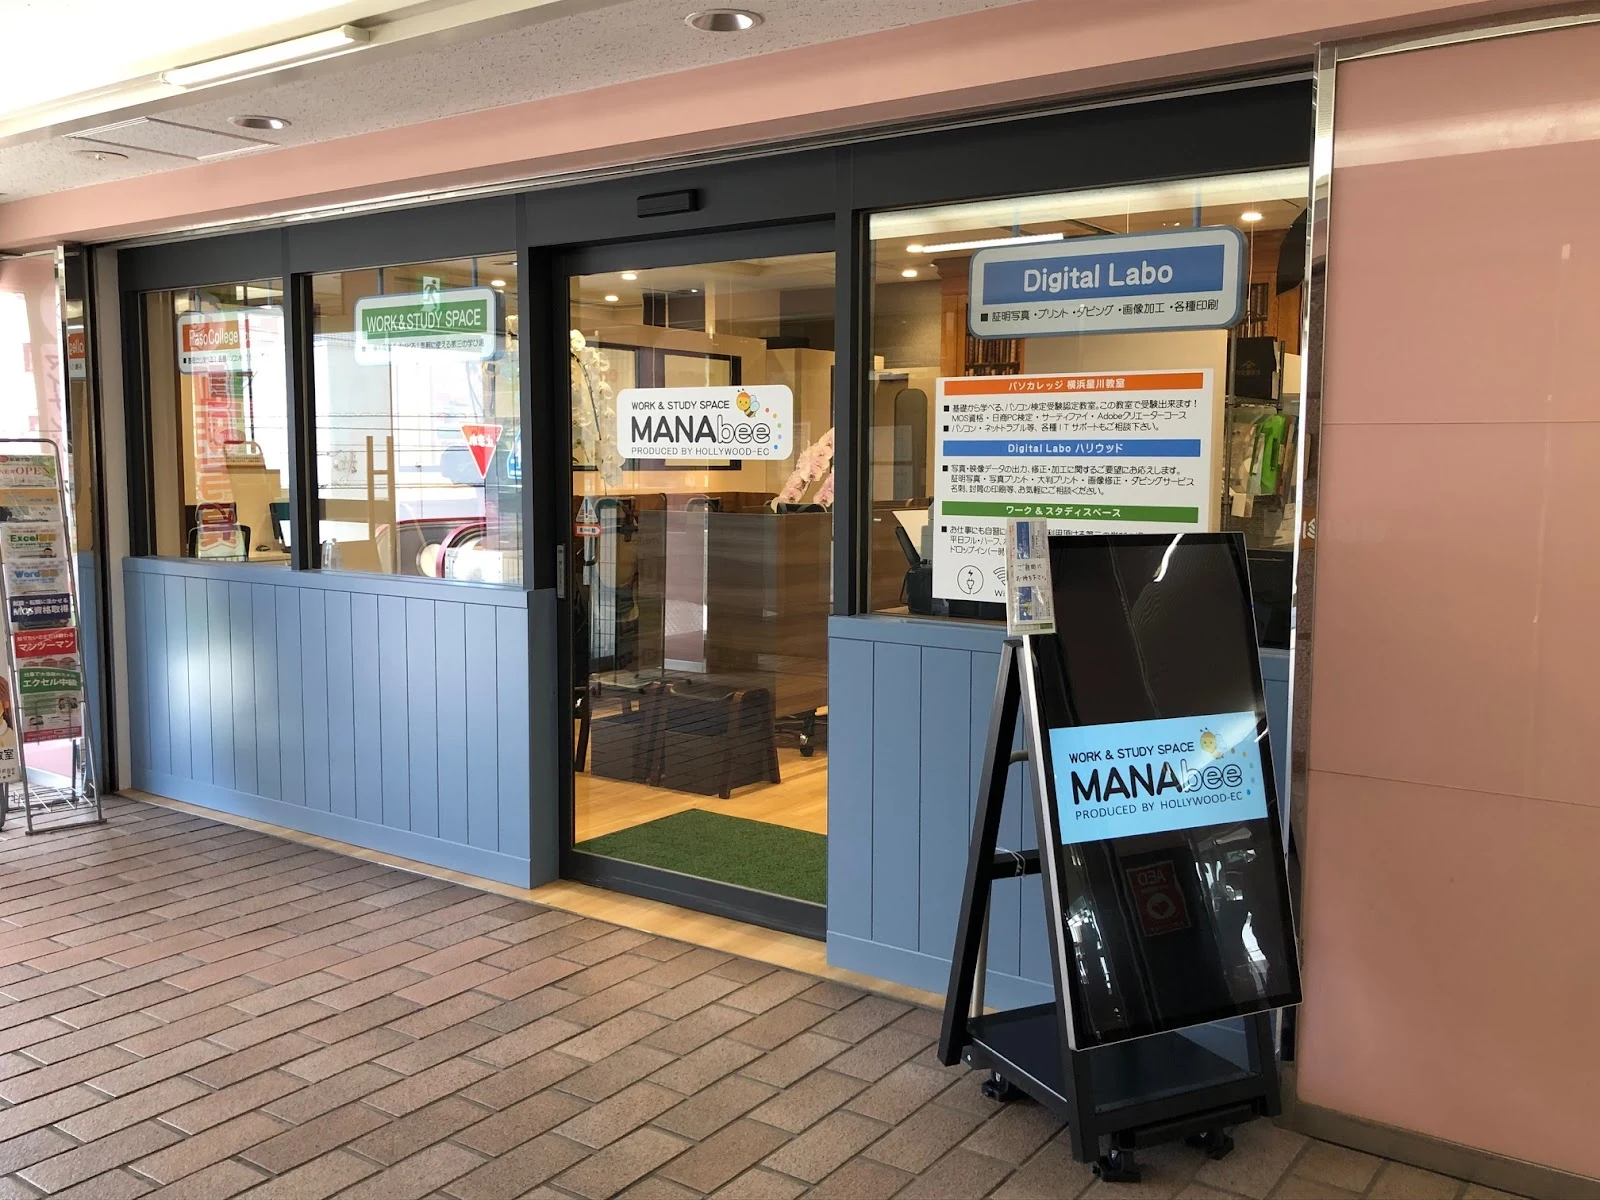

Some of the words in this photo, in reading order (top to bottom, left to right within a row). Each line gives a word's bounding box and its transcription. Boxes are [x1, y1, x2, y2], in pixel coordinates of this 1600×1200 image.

[1023, 264, 1100, 293] Digital
[1108, 260, 1173, 287] Labo
[445, 308, 481, 327] SPACE
[1008, 380, 1063, 392] パソカレッジ
[1066, 378, 1125, 390] 横浜星川教室
[631, 401, 655, 411] WORK
[658, 402, 665, 410] &
[667, 401, 698, 410] STUDY
[699, 400, 730, 410] SPACE
[631, 414, 771, 444] MANAbee
[631, 447, 678, 456] PRODUCED
[681, 447, 694, 456] BY
[695, 447, 770, 456] HOLLYWOOD-EC
[1007, 443, 1043, 454] Digital
[1045, 443, 1072, 453] Labo
[1075, 443, 1124, 454] ハリウッド
[1005, 505, 1032, 514] ワーク
[1035, 506, 1043, 515] &
[1045, 506, 1121, 518] スタディスペース
[18, 640, 74, 652] マンツーマン
[23, 677, 78, 687] エクセル中級
[1069, 750, 1102, 764] WORK
[1105, 750, 1114, 760] &
[1117, 745, 1154, 759] STUDY
[1157, 741, 1195, 755] SPACE
[1070, 758, 1243, 806] MANAbee
[1075, 804, 1137, 820] PRODUCED
[1142, 803, 1155, 813] BY
[1160, 791, 1243, 810] HOLLYWOOD-EC
